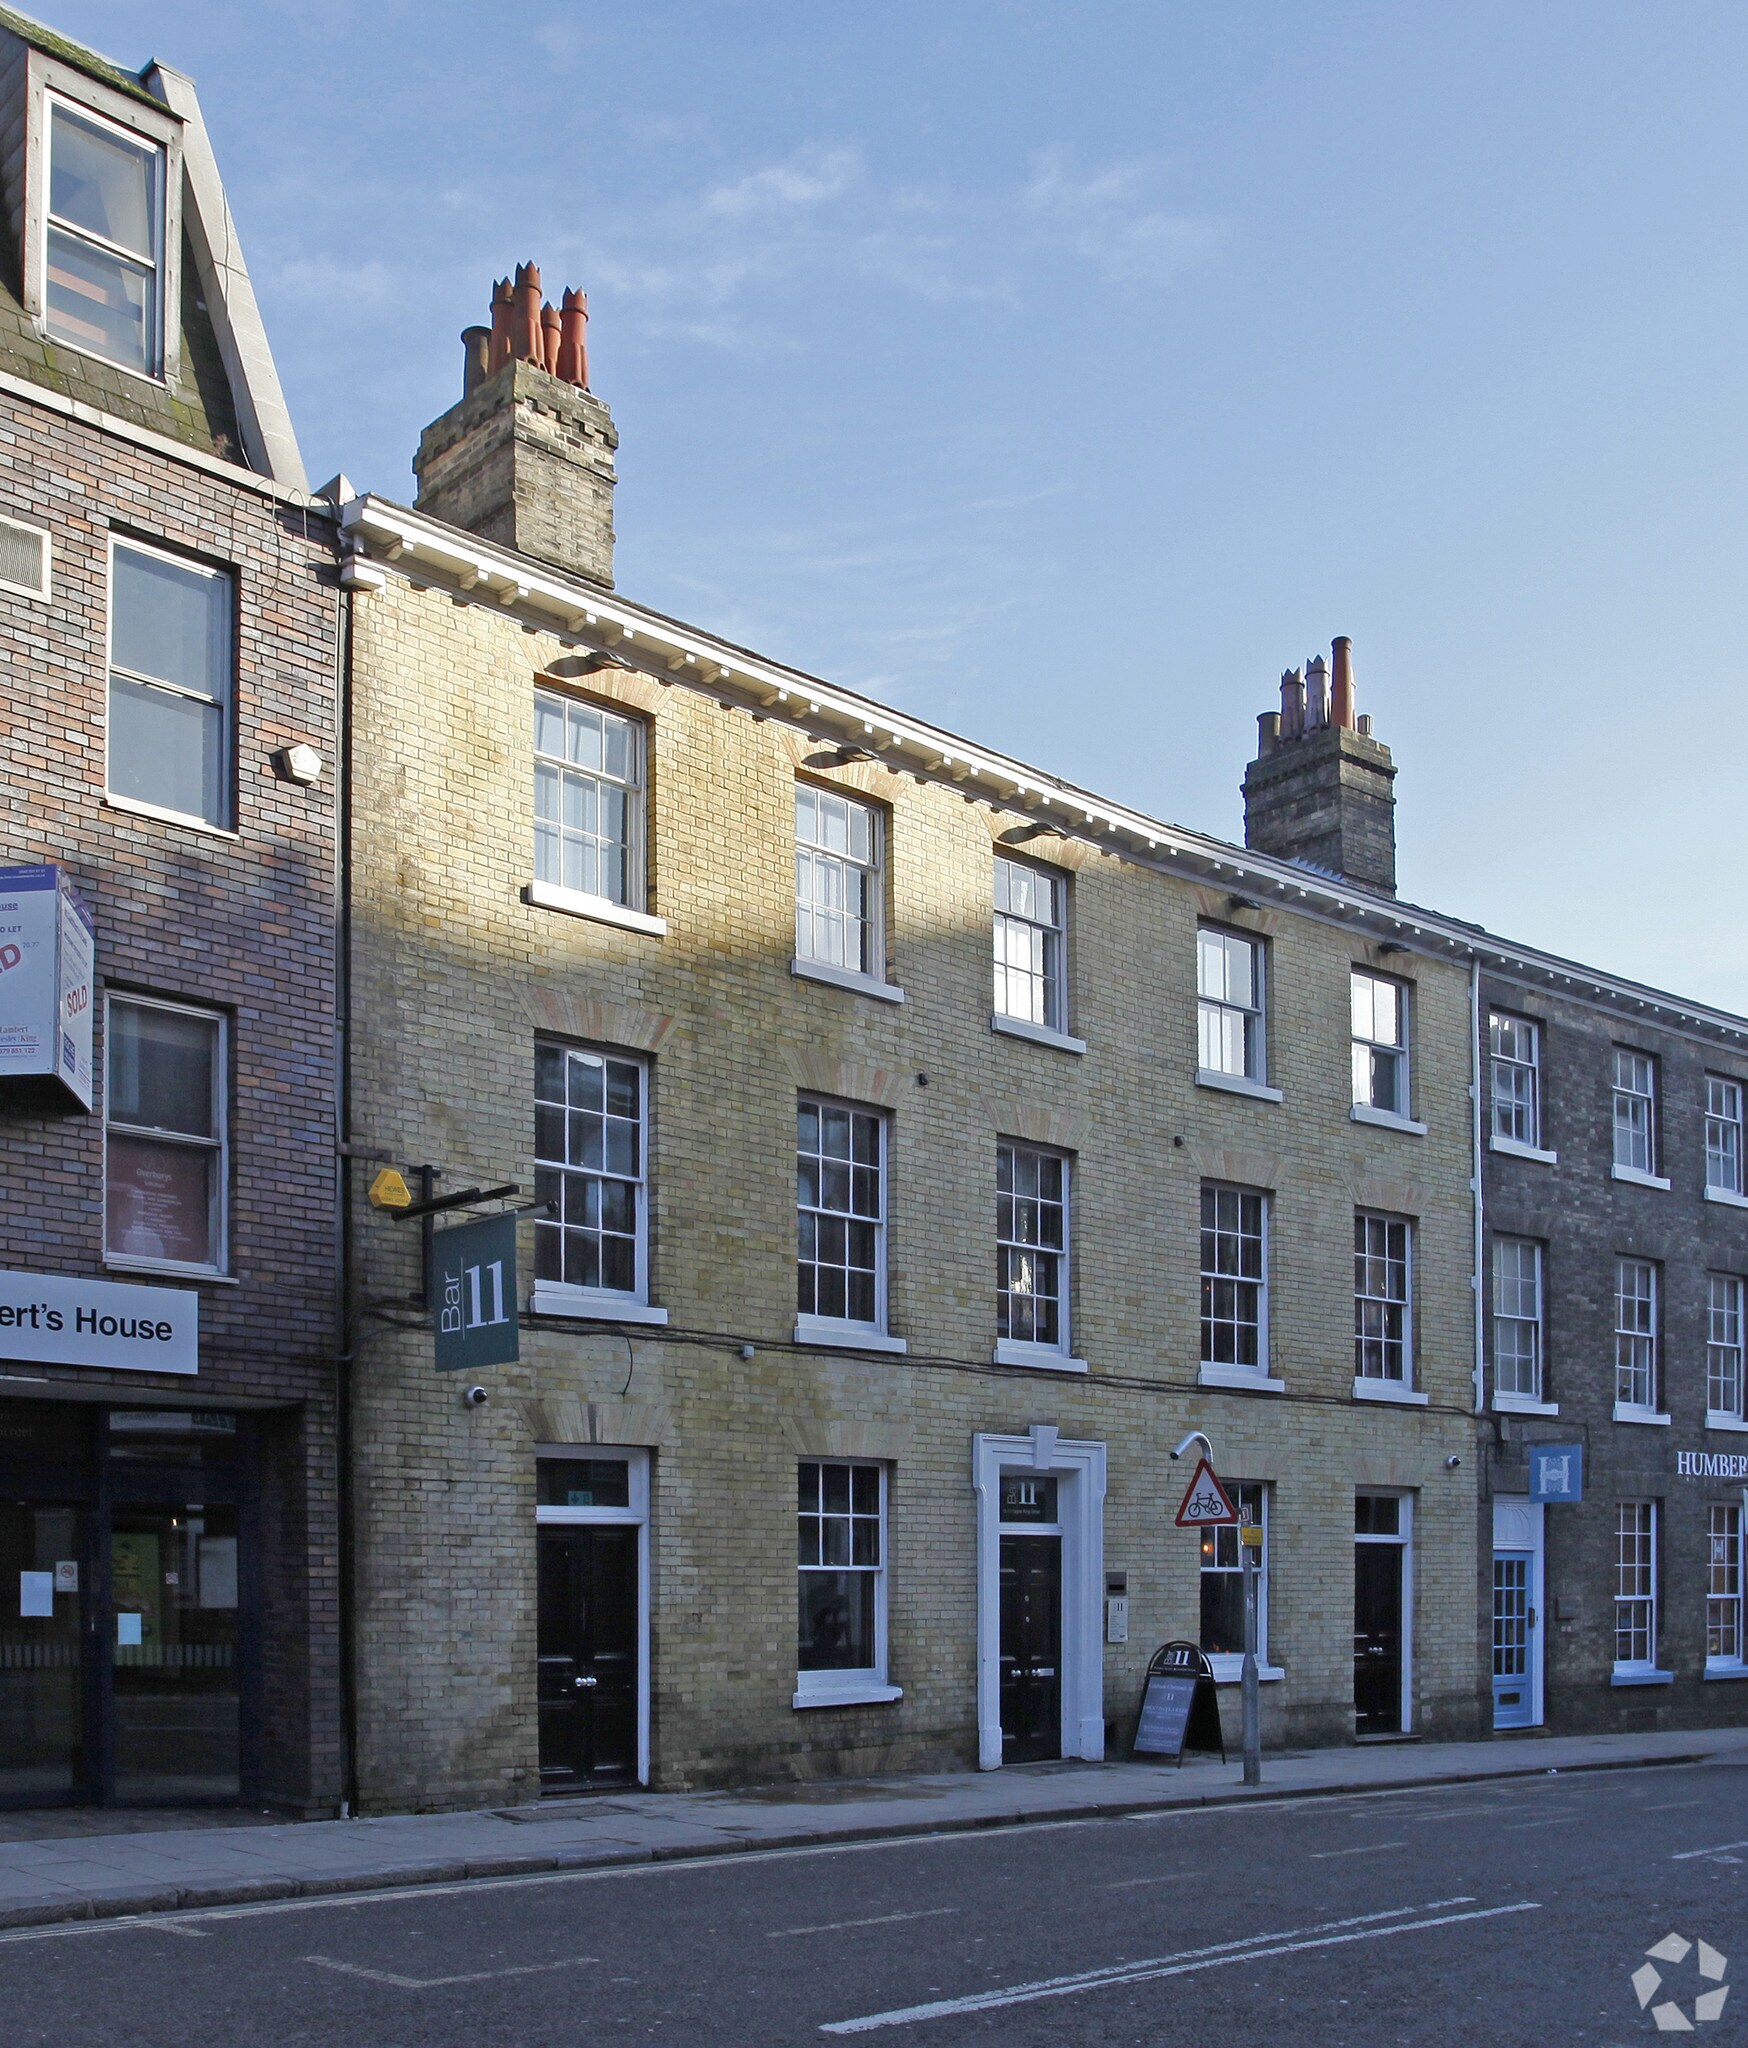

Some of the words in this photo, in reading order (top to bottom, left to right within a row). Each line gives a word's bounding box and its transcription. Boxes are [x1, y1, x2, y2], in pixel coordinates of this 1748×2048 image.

[0, 902, 18, 910] use
[67, 985, 88, 1017] SOLD
[441, 1271, 461, 1333] Bar
[465, 1260, 510, 1329] 11
[75, 1306, 173, 1342] House
[1676, 1451, 1748, 1478] HUMBER
[1019, 1481, 1037, 1505] 11
[1173, 1650, 1190, 1666] 11
